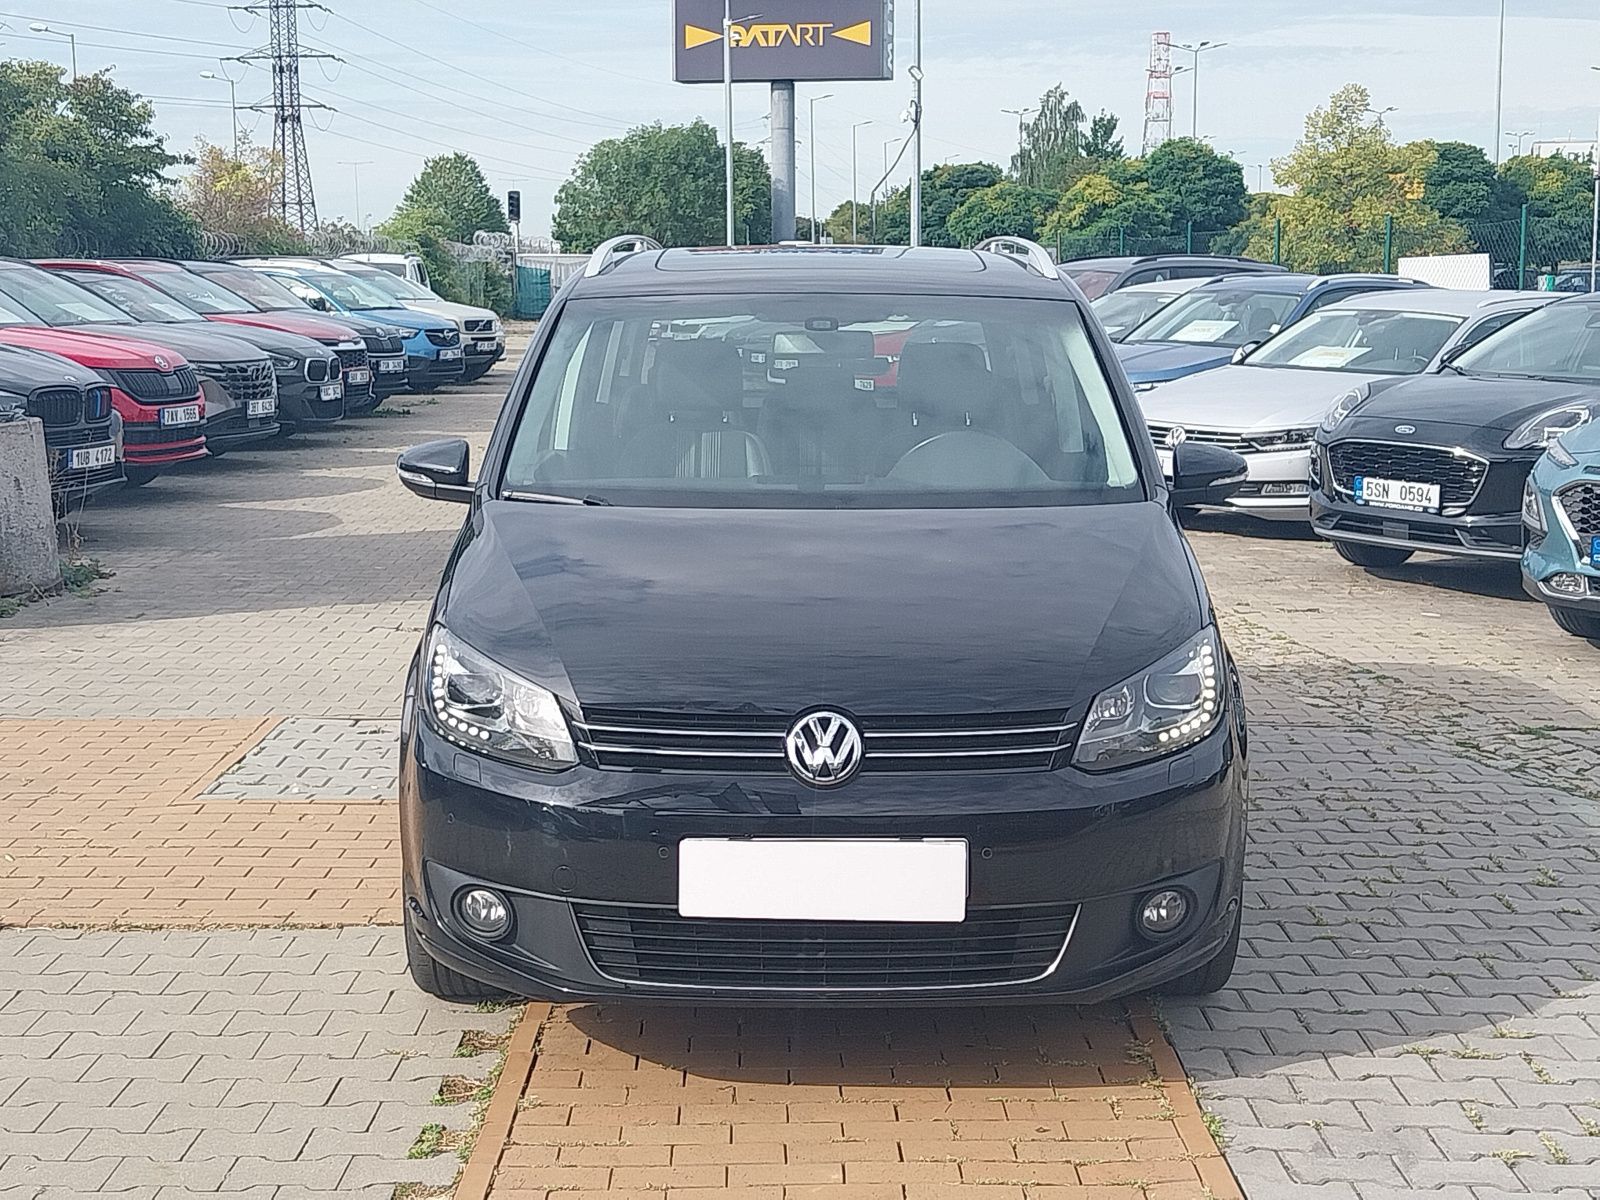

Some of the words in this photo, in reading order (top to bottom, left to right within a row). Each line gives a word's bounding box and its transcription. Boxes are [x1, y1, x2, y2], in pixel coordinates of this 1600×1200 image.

[95, 447, 113, 464] 4172
[1366, 481, 1390, 500] 5SN
[1399, 485, 1432, 504] 0594
